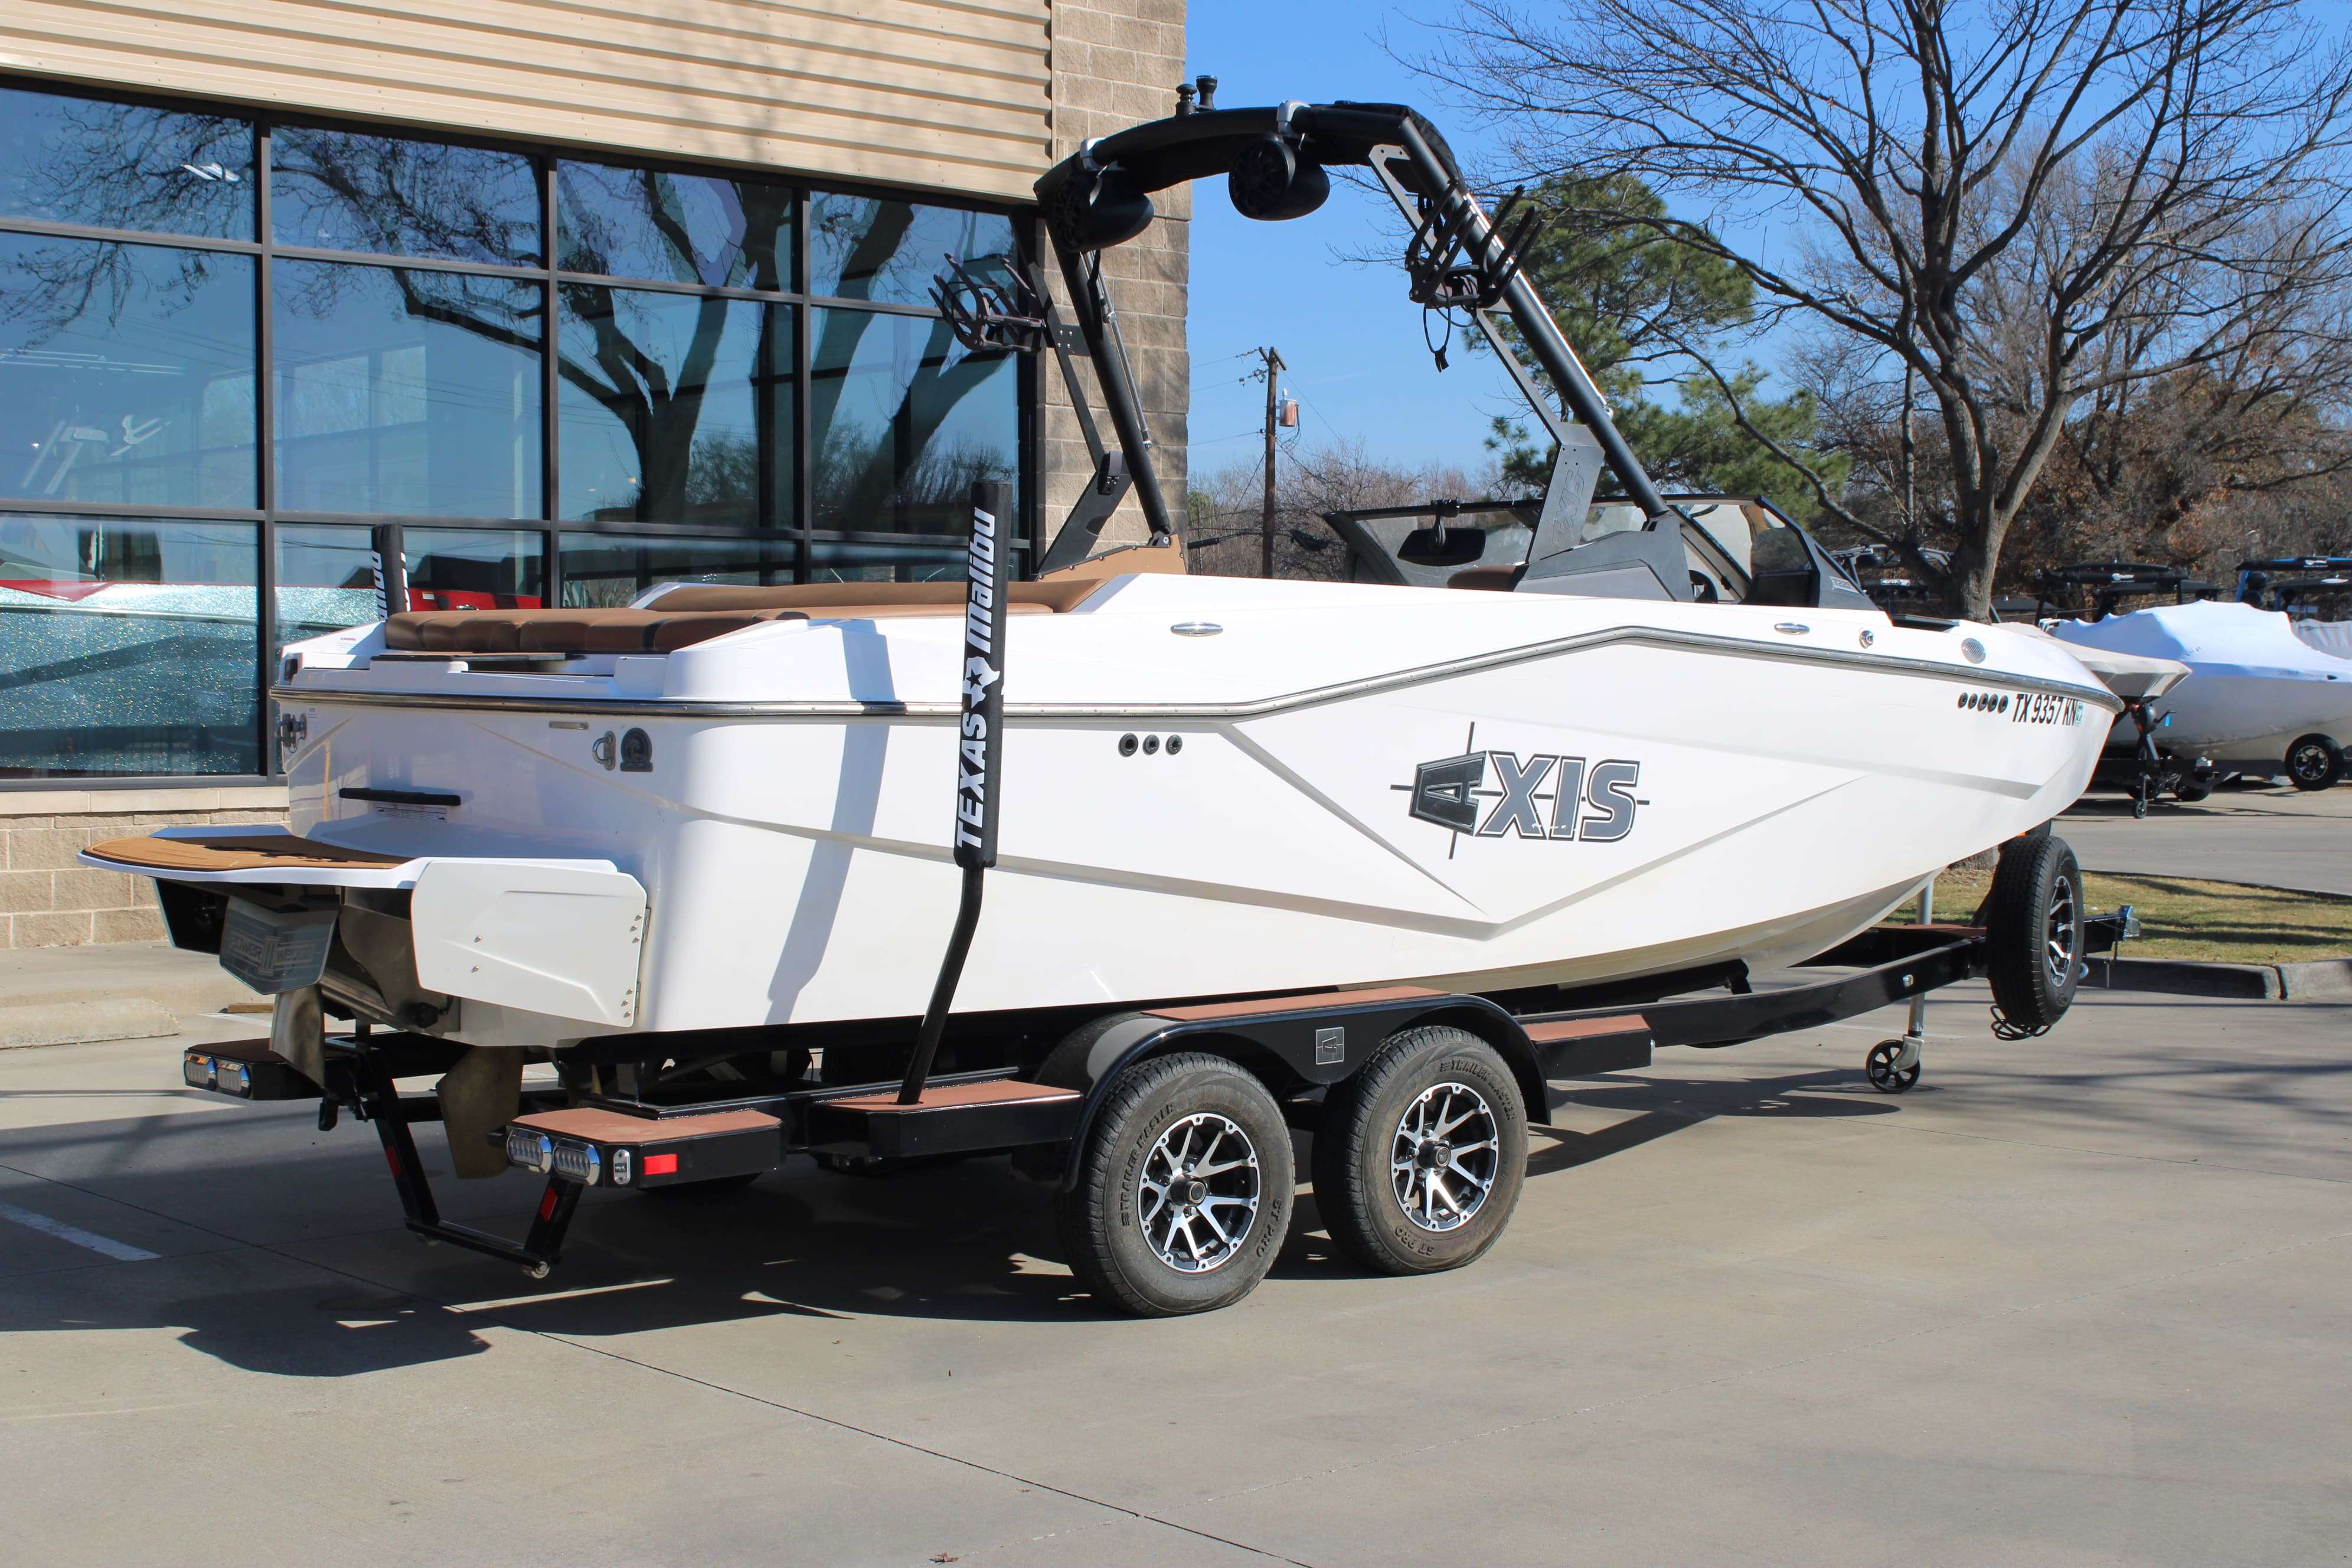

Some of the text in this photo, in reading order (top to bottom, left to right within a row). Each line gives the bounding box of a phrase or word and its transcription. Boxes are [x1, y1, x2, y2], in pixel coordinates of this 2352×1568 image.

[956, 506, 996, 849] TEXAS Malibu
[2012, 693, 2033, 722] TX
[2031, 694, 2064, 724] 9357
[1409, 750, 1641, 843] AXIS
[1120, 1149, 1138, 1211] TRAILER
